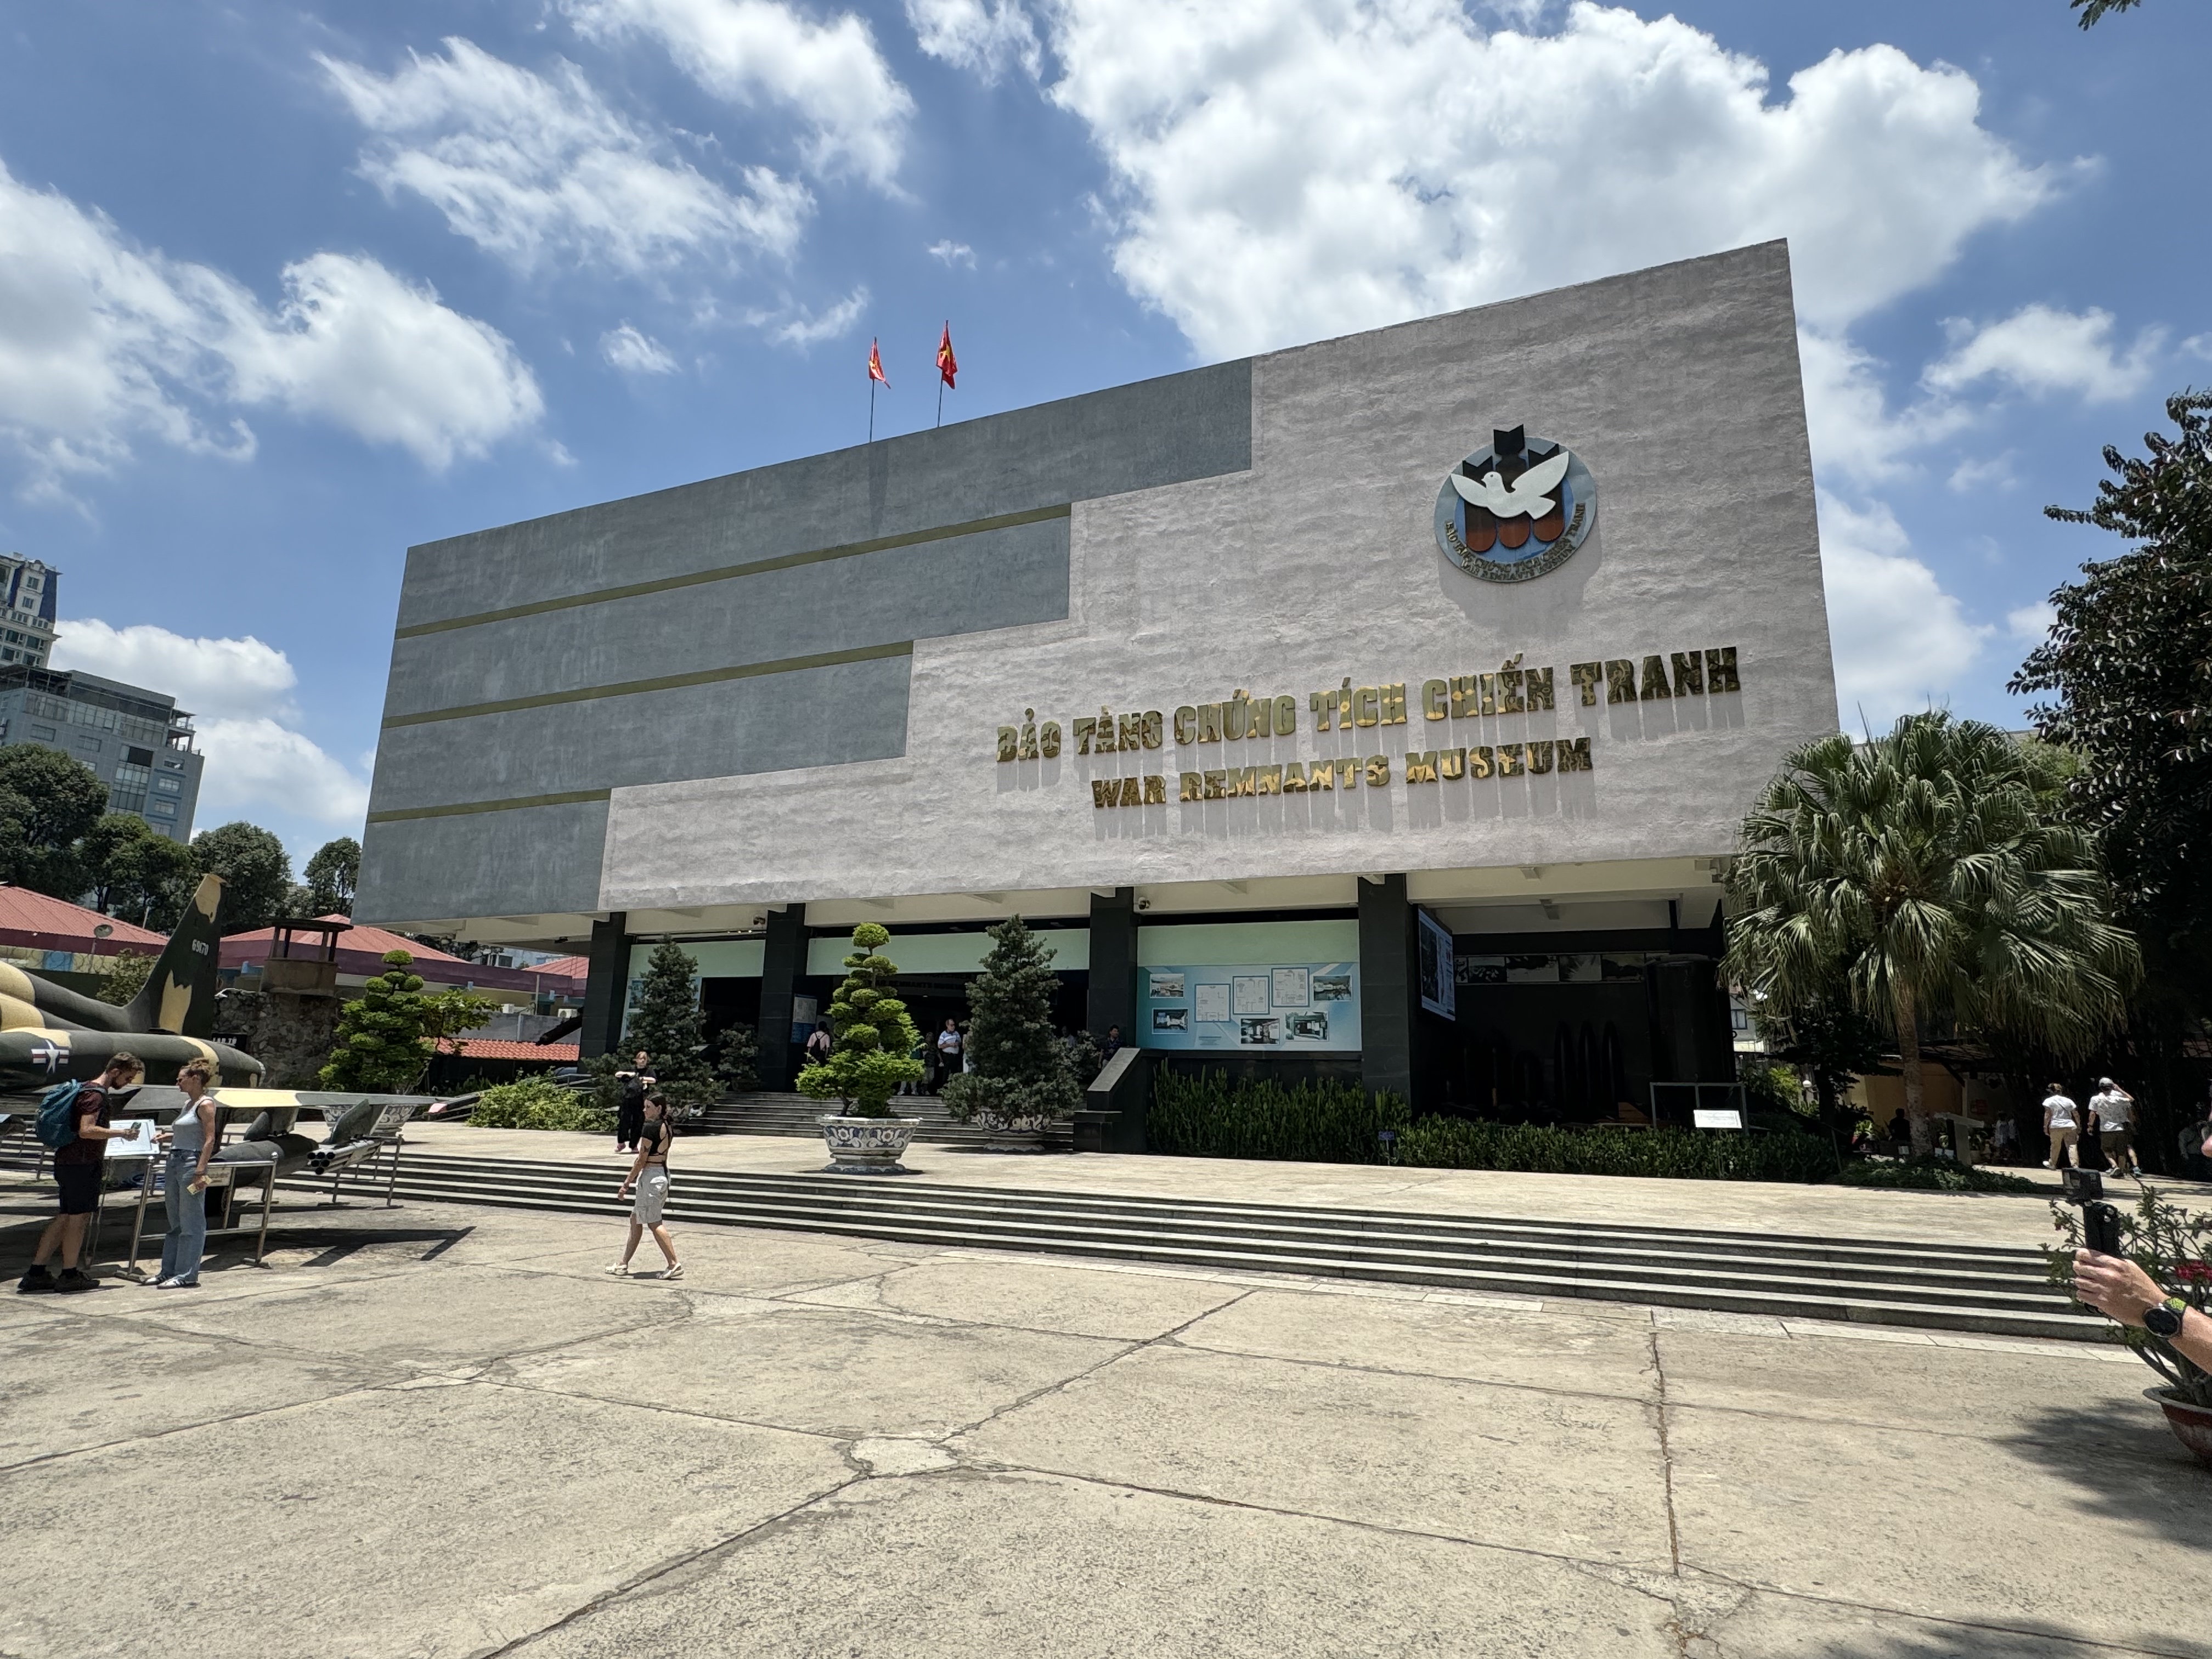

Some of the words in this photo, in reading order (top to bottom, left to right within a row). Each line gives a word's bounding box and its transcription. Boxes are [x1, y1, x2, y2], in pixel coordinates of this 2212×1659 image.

[996, 708, 1061, 761] BẢO
[1073, 704, 1163, 755] TÀNG
[1174, 689, 1296, 745] CHỨNG
[1310, 677, 1407, 731] TÍCH
[1422, 653, 1554, 720] CHIẾN
[1570, 646, 1740, 706] TRANH
[1092, 775, 1166, 808] WAR
[1180, 755, 1390, 802] REMNANTS
[1404, 737, 1592, 784] MUSEUM
